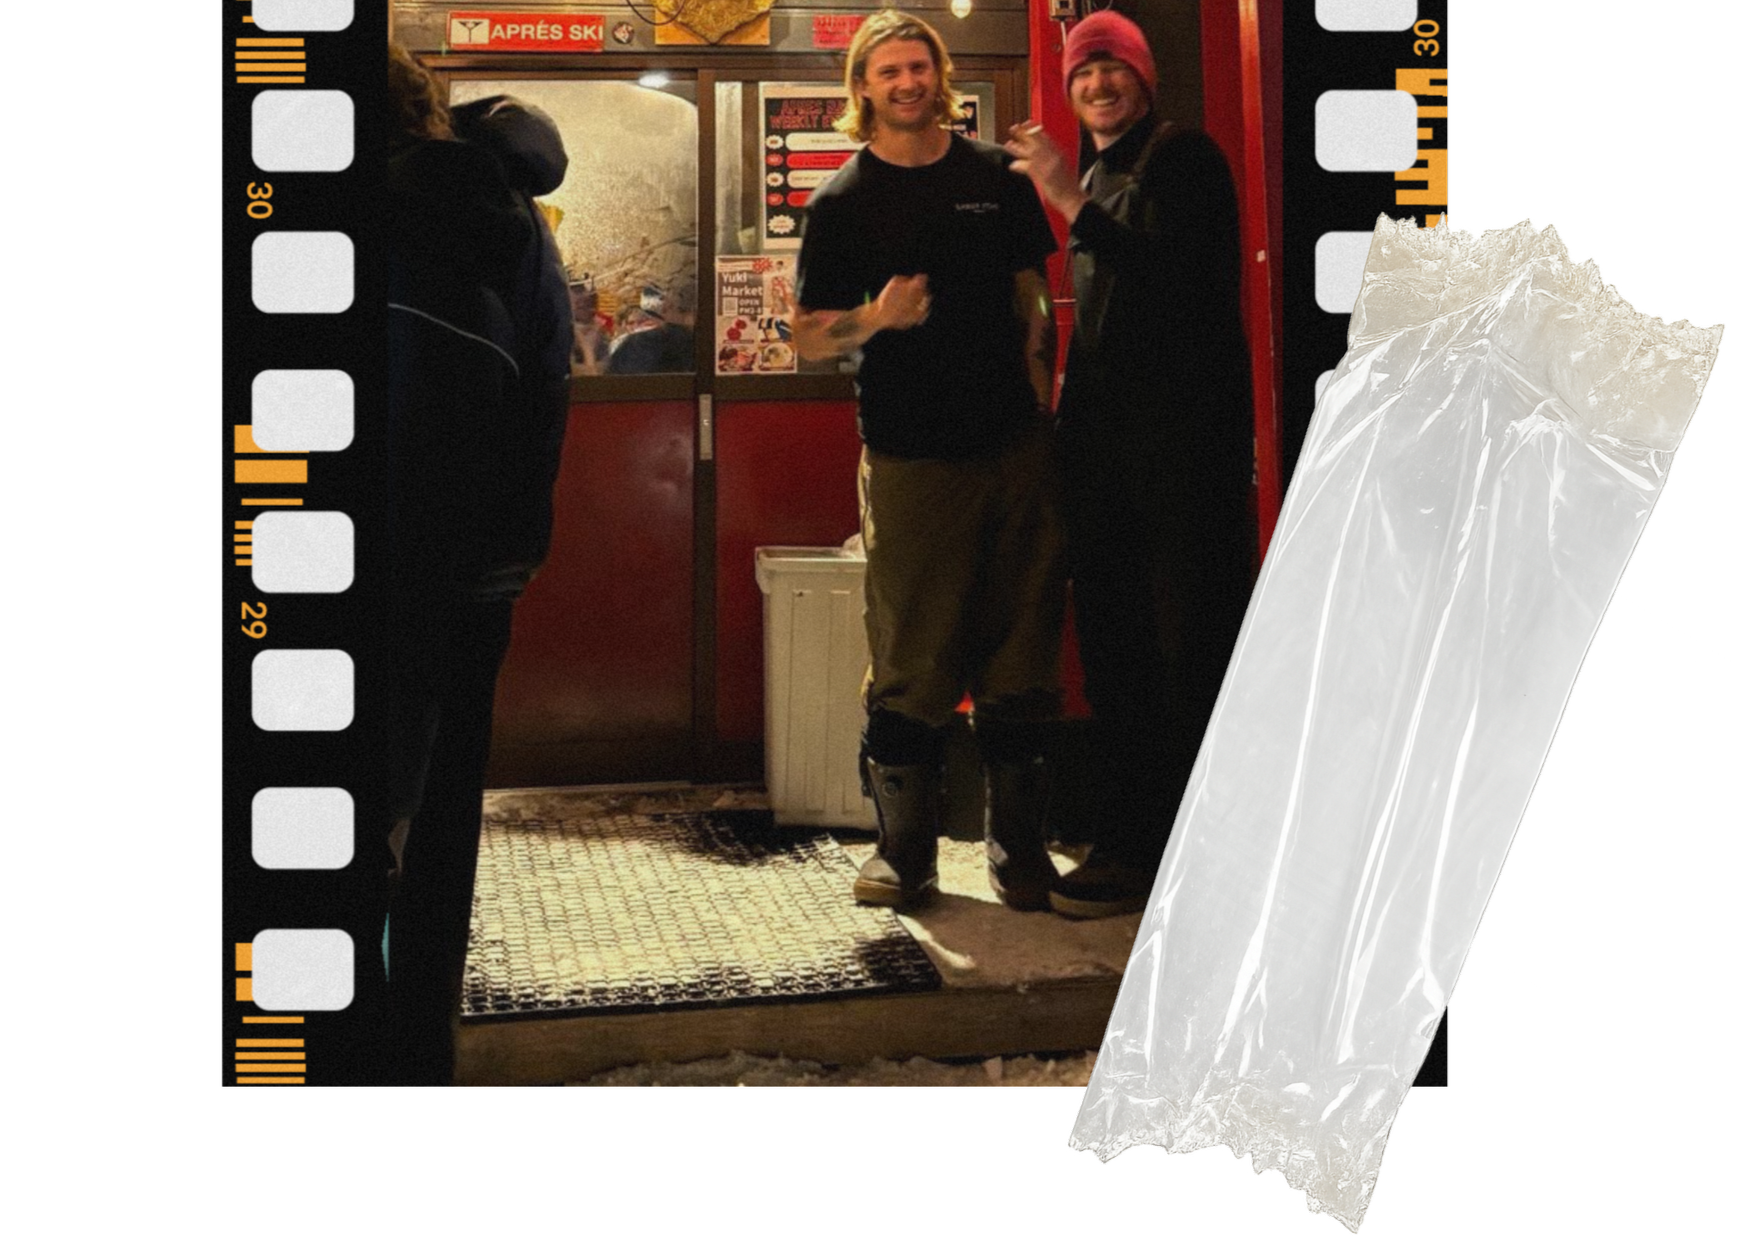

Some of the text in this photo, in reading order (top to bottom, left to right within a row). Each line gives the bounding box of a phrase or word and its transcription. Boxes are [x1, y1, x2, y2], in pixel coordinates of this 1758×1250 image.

[568, 24, 604, 40] SKI
[722, 272, 748, 283] Yuki
[722, 285, 763, 296] Market
